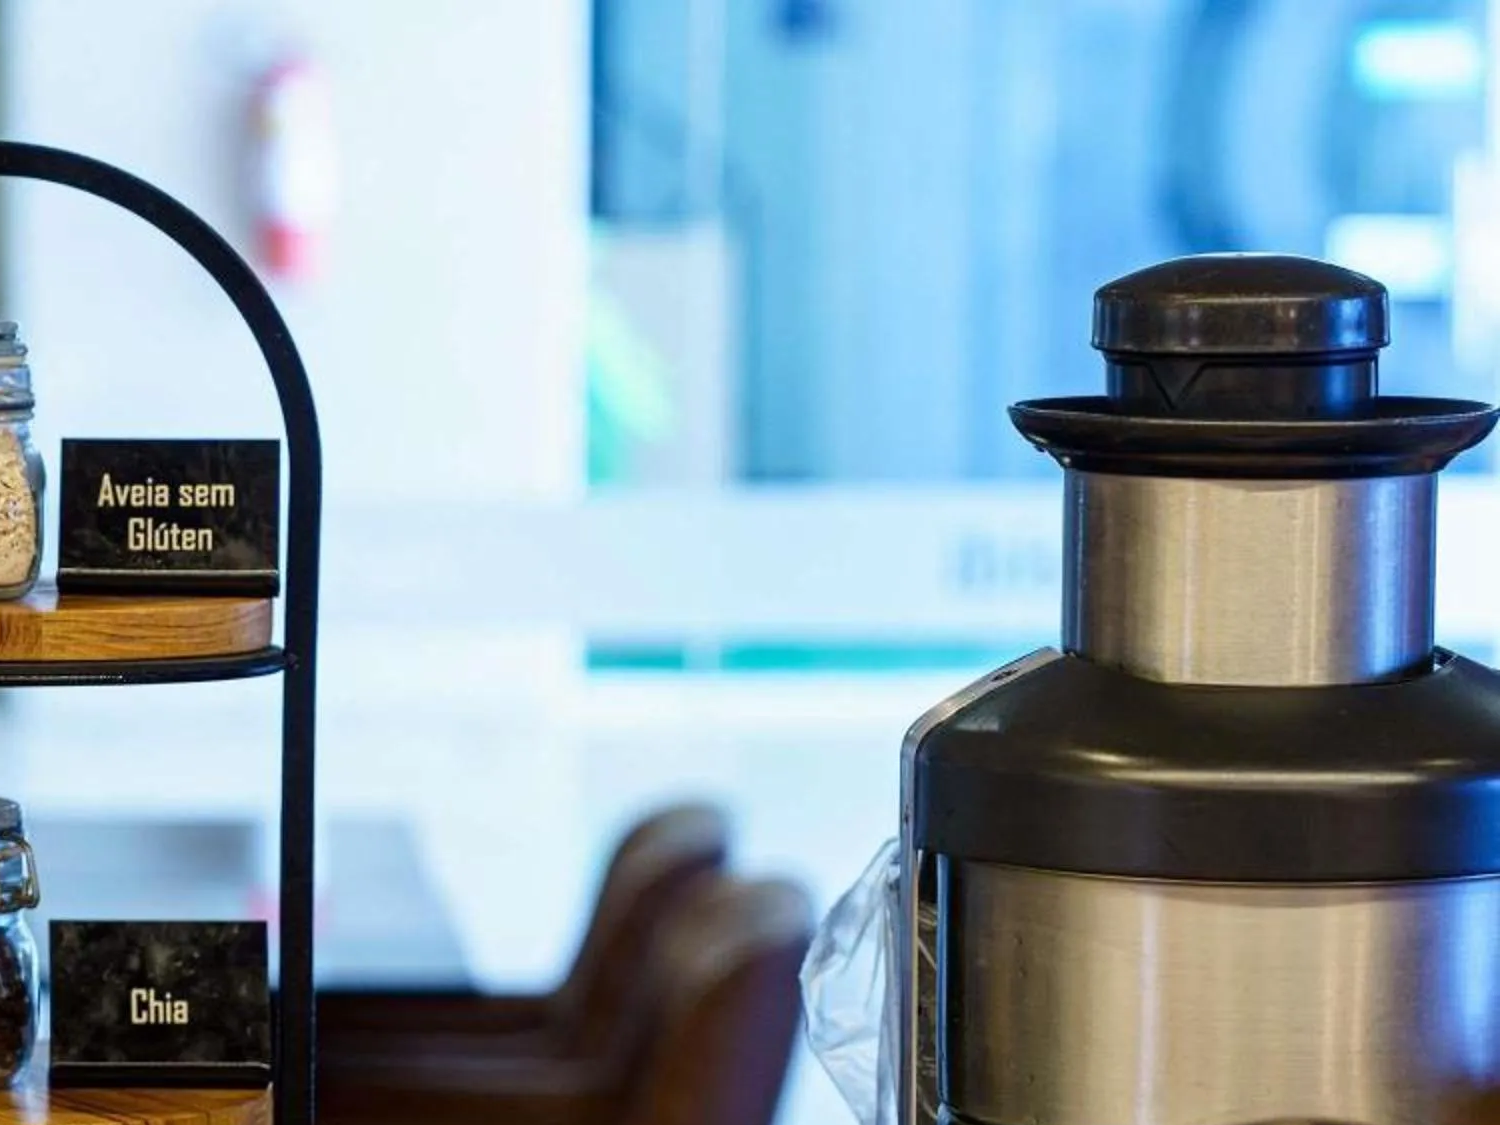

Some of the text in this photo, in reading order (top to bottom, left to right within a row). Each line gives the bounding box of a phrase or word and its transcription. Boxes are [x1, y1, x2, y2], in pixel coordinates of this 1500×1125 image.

[97, 472, 236, 507] Aveia sem
[127, 517, 214, 551] Glúten
[130, 987, 189, 1025] Chia
